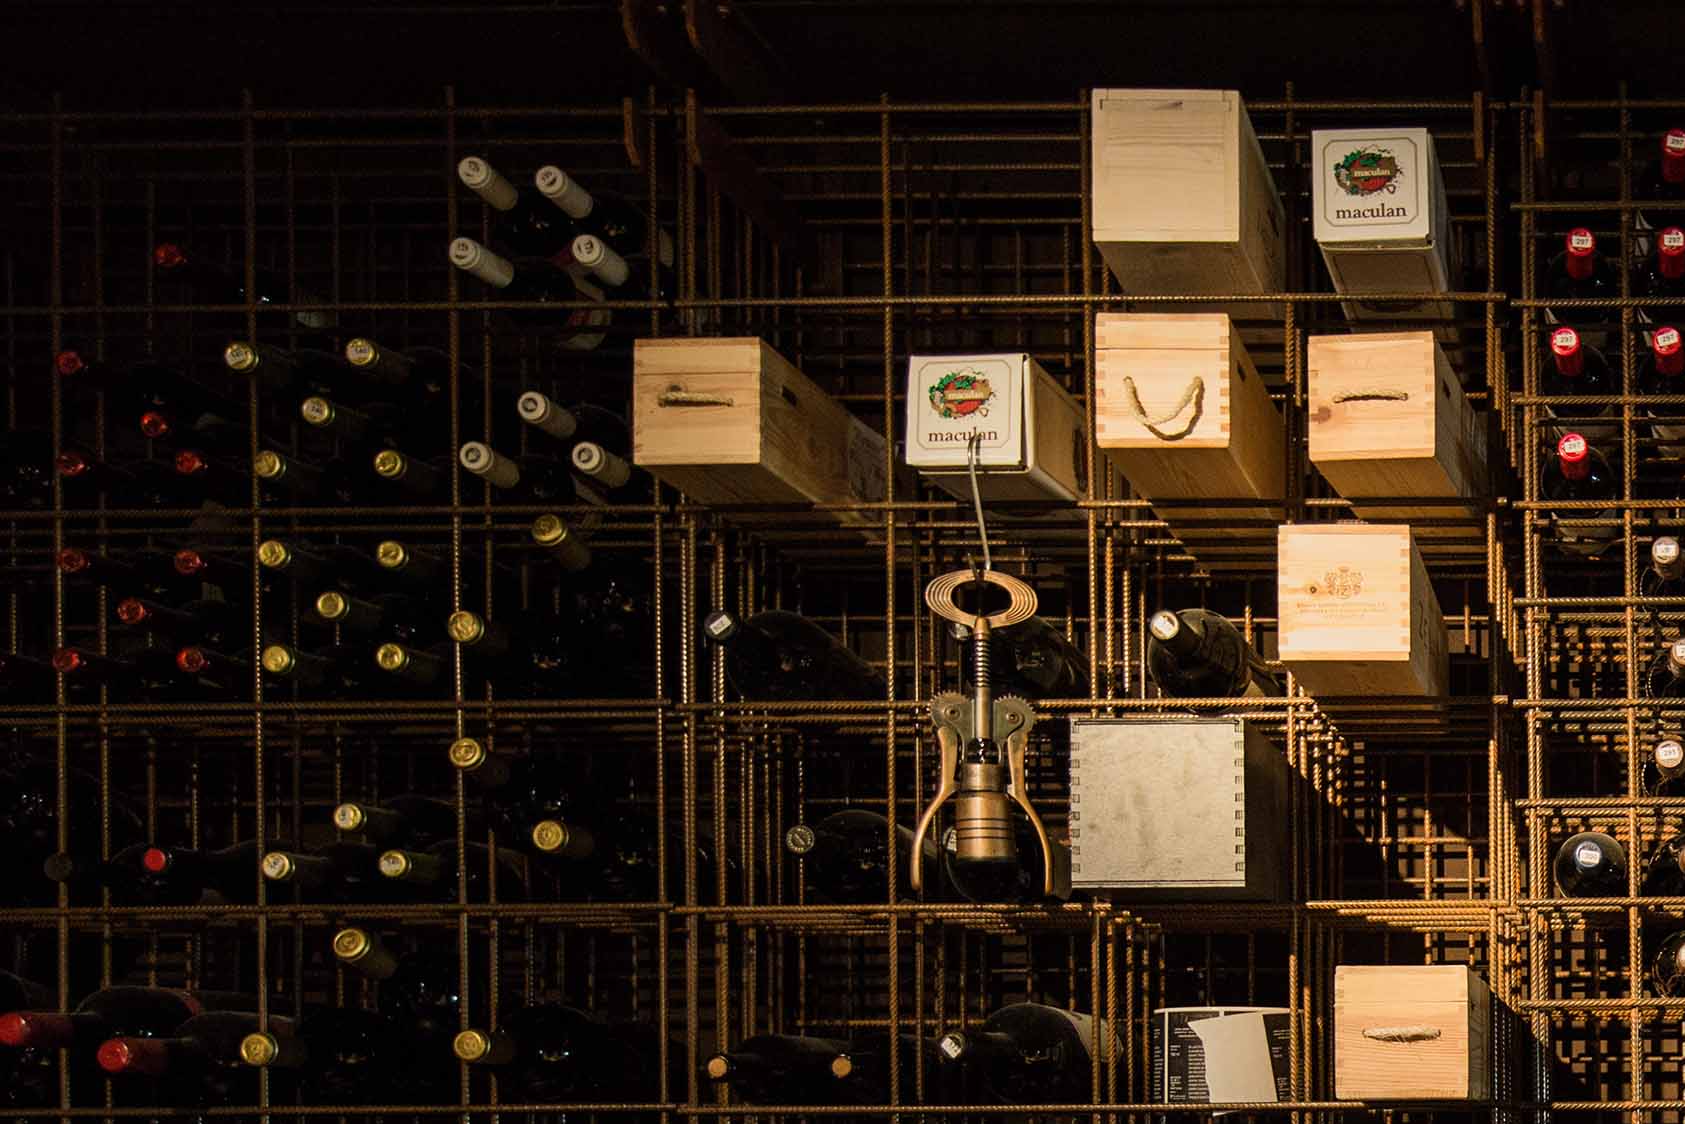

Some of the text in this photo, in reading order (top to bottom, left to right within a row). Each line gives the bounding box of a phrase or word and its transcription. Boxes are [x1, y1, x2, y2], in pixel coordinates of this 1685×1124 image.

[1353, 168, 1391, 178] maculan
[1335, 203, 1408, 220] maculan
[928, 426, 999, 442] maculan
